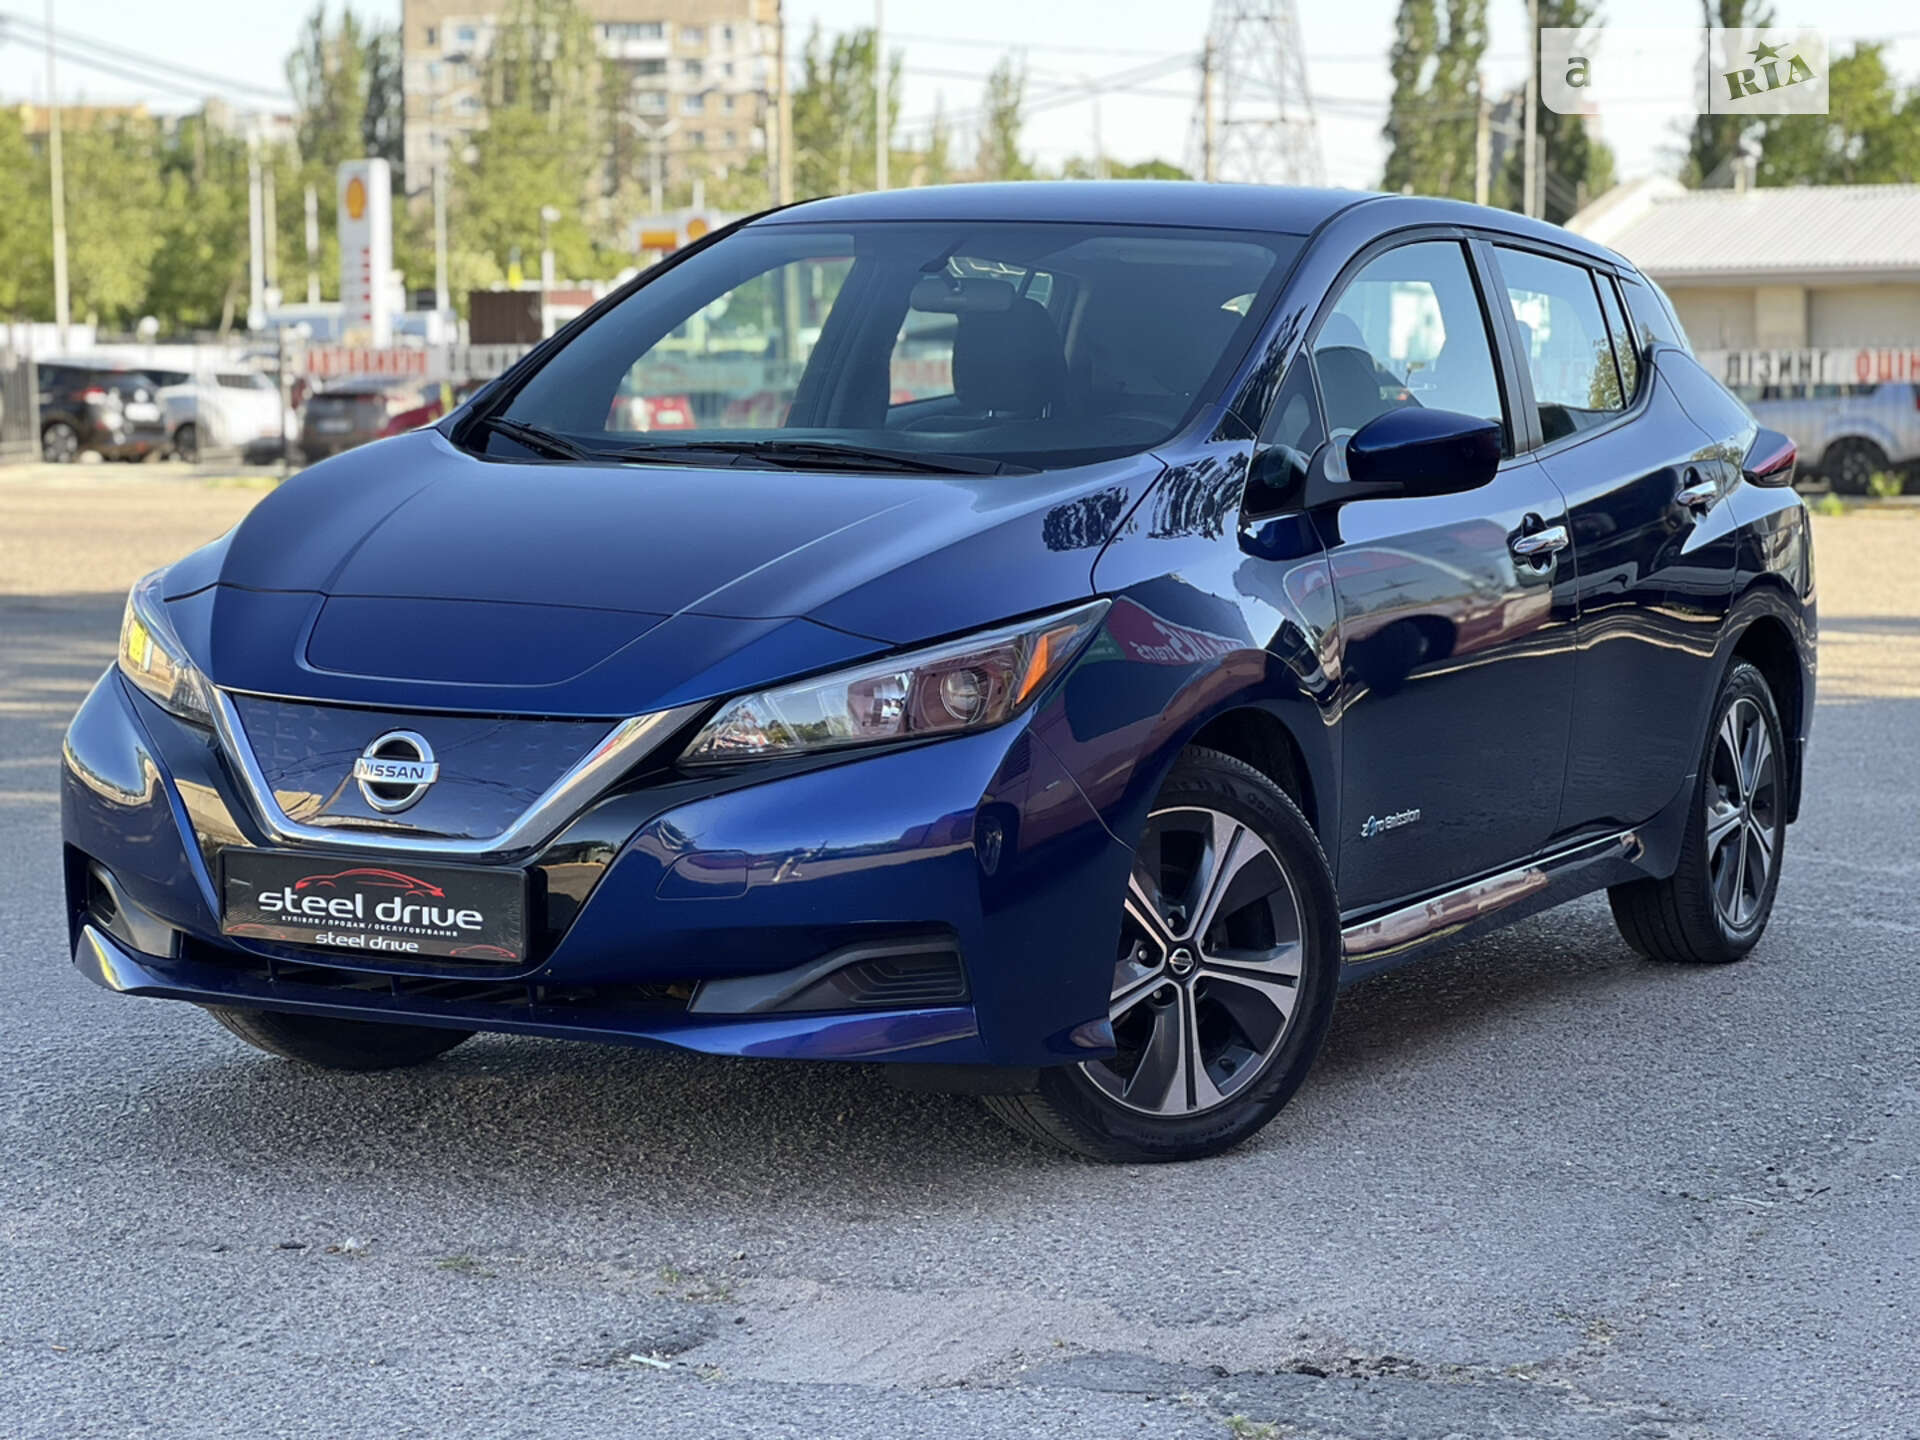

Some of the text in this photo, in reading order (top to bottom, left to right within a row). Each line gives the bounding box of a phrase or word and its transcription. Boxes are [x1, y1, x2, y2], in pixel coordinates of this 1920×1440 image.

[359, 763, 425, 780] NISSAN
[258, 886, 483, 931] steel drive
[315, 931, 419, 953] steel drive
